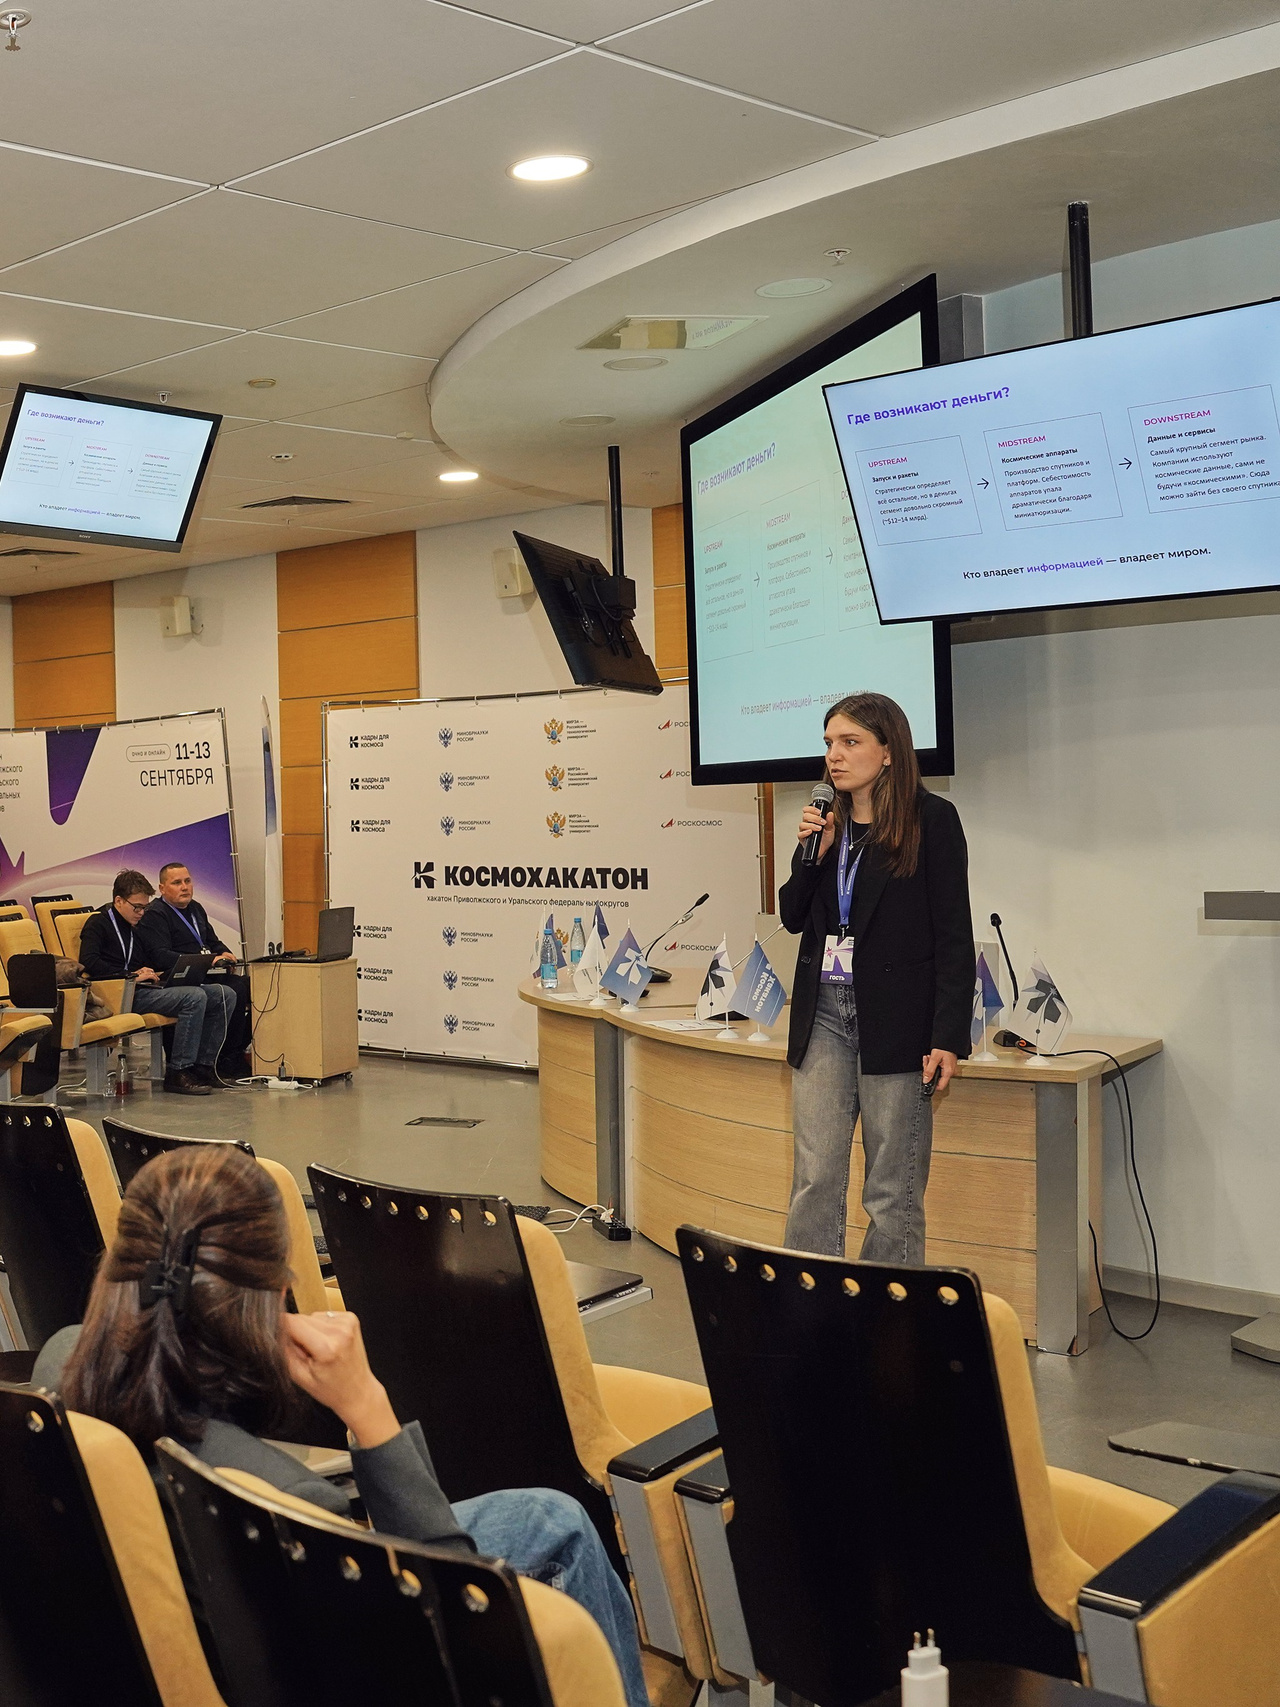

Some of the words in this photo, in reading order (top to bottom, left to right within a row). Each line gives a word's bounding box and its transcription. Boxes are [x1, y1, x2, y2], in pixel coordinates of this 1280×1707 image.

[847, 413, 871, 425] Где
[874, 398, 948, 420] возникают
[952, 386, 1010, 408] деньги?
[27, 409, 40, 417] Где
[40, 412, 76, 422] возникают
[77, 416, 104, 426] деньги?
[1144, 410, 1211, 426] DOWNSTREAM
[998, 435, 1046, 448] MIDSTREAM
[1147, 432, 1176, 444] Данные
[1184, 427, 1216, 438] сервисы
[1150, 446, 1174, 456] Самый
[1176, 442, 1208, 454] крупный
[1209, 439, 1238, 448] сегмент
[1240, 434, 1267, 444] рынка.
[868, 456, 908, 468] UPSTREAM
[1001, 452, 1044, 464] Космические
[1045, 448, 1078, 458] аппараты
[1152, 458, 1189, 468] Компании
[1190, 452, 1234, 462] используют
[698, 480, 709, 495] Где
[710, 461, 744, 488] возникают
[746, 442, 776, 472] деньги?
[1004, 466, 1050, 477] Производство
[1050, 461, 1084, 472] спутников
[1155, 468, 1202, 478] космические
[1202, 464, 1234, 474] данные,
[872, 474, 892, 483] Запуск
[898, 471, 919, 480] ракеты
[1006, 477, 1040, 487] платформ.
[1042, 471, 1092, 483] Себестоимость
[874, 484, 916, 496] Стратегически
[917, 480, 951, 491] определяет
[1010, 489, 1043, 498] аппаратов
[1044, 486, 1062, 495] упала
[1157, 481, 1182, 490] будучи
[1160, 493, 1184, 501] можно
[1186, 490, 1206, 498] зайти
[1222, 484, 1246, 493] своего
[1012, 498, 1057, 509] драматически
[1058, 493, 1092, 503] благодаря
[963, 570, 981, 580] Кто
[984, 566, 1025, 578] владеет
[1026, 556, 1104, 574] информацией
[1120, 551, 1165, 564] владеет
[1168, 546, 1212, 558] миром.
[740, 706, 750, 715] Кто
[750, 703, 771, 714] владеет
[772, 695, 812, 712] информацией
[175, 742, 210, 760] 11-13
[140, 768, 214, 787] СЕНТЯБРЯ
[444, 866, 648, 890] КОСМОХАКАТОН
[453, 895, 501, 904] Приволжского
[508, 897, 548, 907] Уральского
[599, 900, 629, 909] округов
